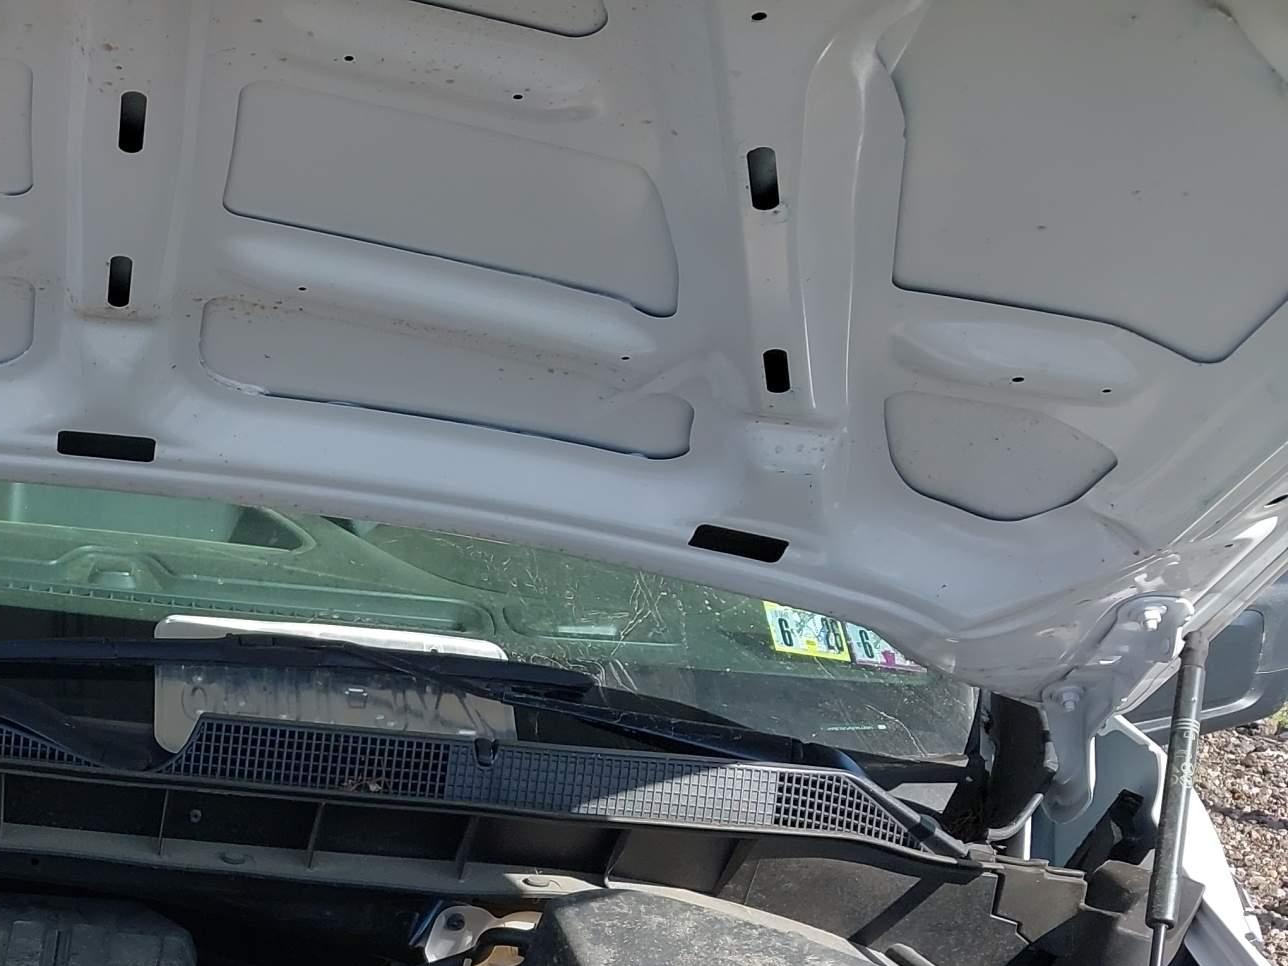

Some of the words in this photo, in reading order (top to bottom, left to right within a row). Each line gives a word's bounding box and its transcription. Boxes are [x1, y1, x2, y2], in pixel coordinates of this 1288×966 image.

[778, 617, 794, 647] 6
[820, 617, 845, 655] 26
[858, 629, 875, 659] 6
